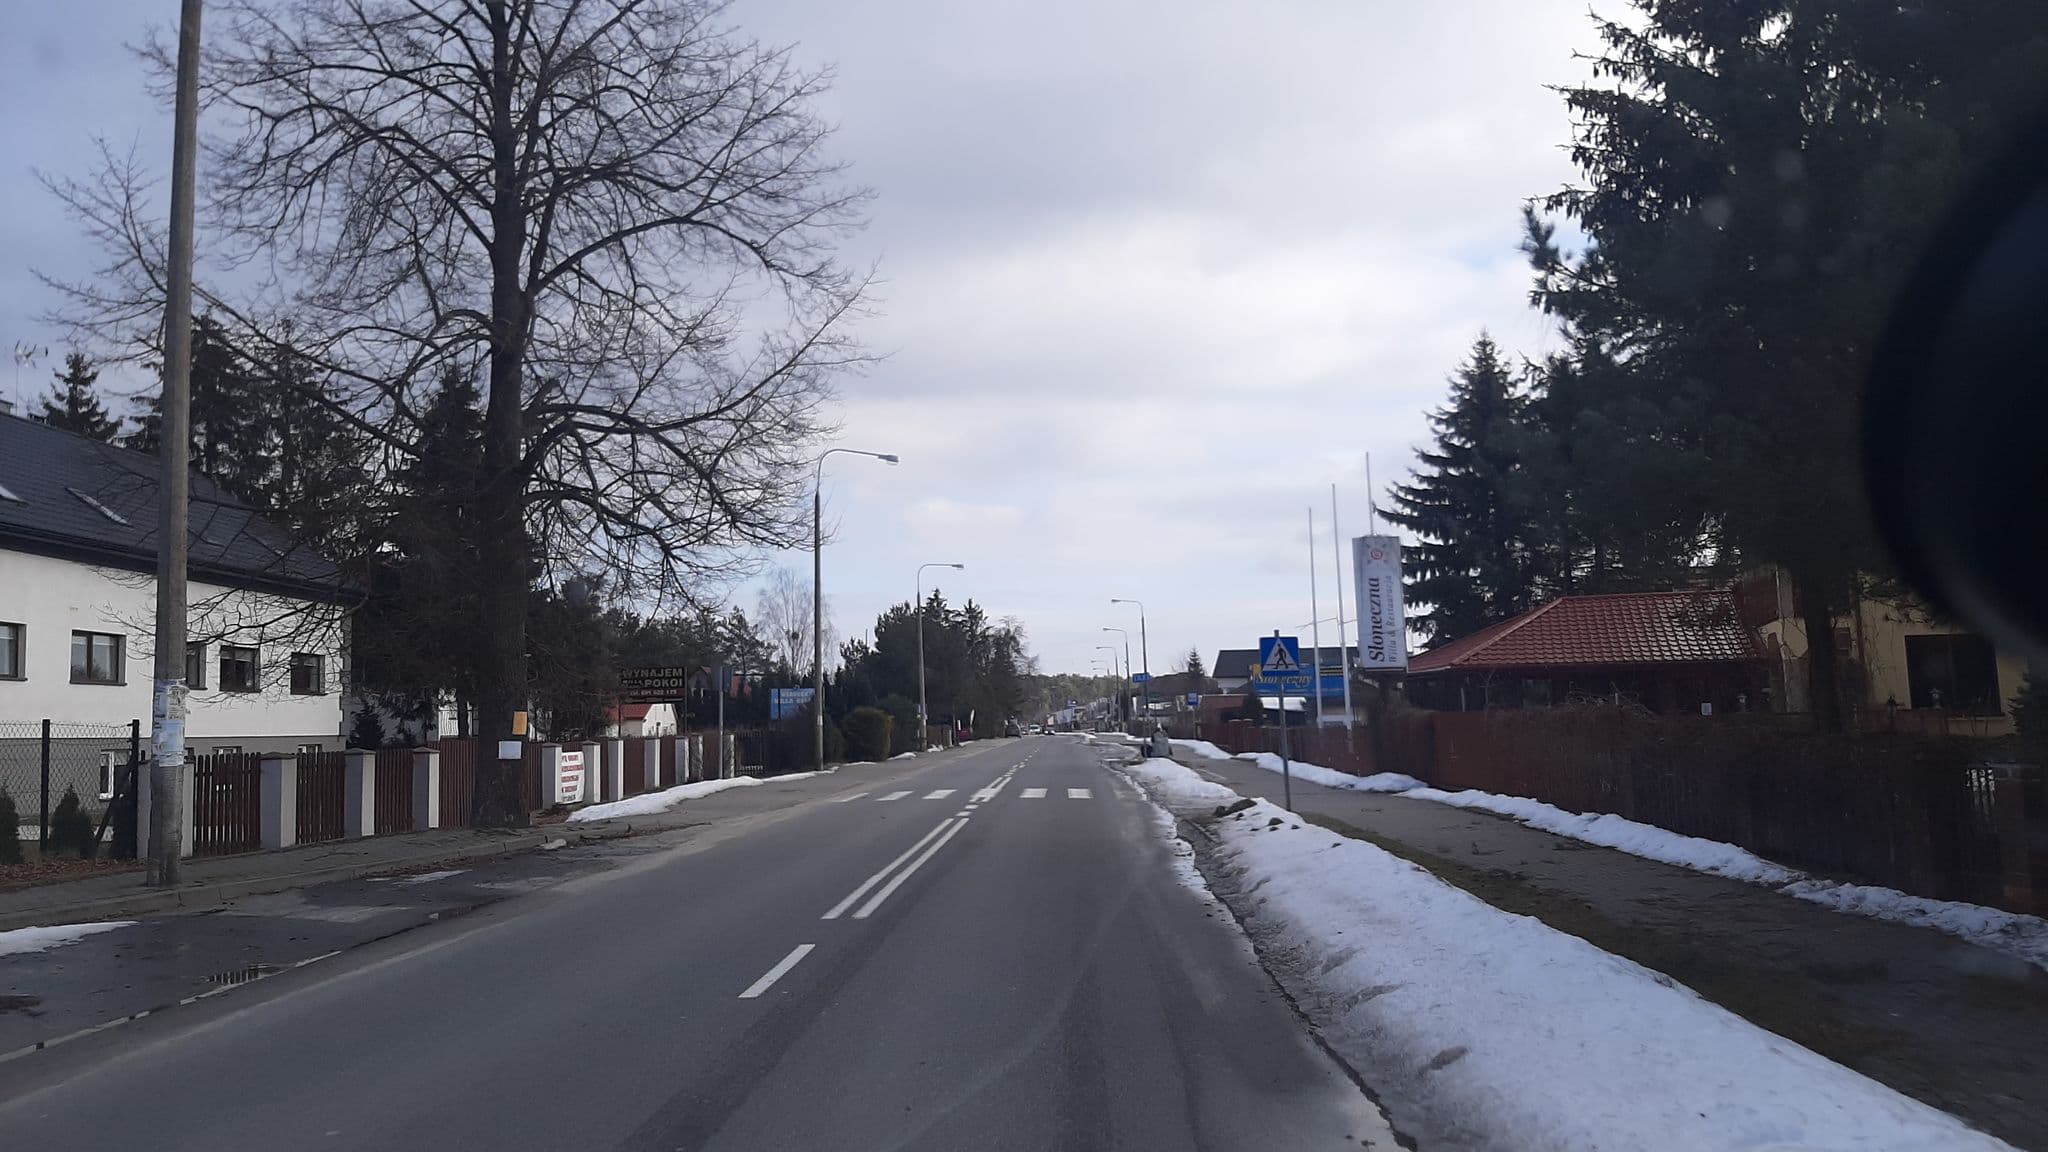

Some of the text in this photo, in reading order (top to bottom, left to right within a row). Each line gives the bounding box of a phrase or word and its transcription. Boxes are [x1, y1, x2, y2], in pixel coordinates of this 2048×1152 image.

[1367, 576, 1385, 662] Słoneczna
[1388, 640, 1398, 663] Willa
[622, 668, 683, 678] WYNAJEM
[644, 678, 683, 688] POKOI
